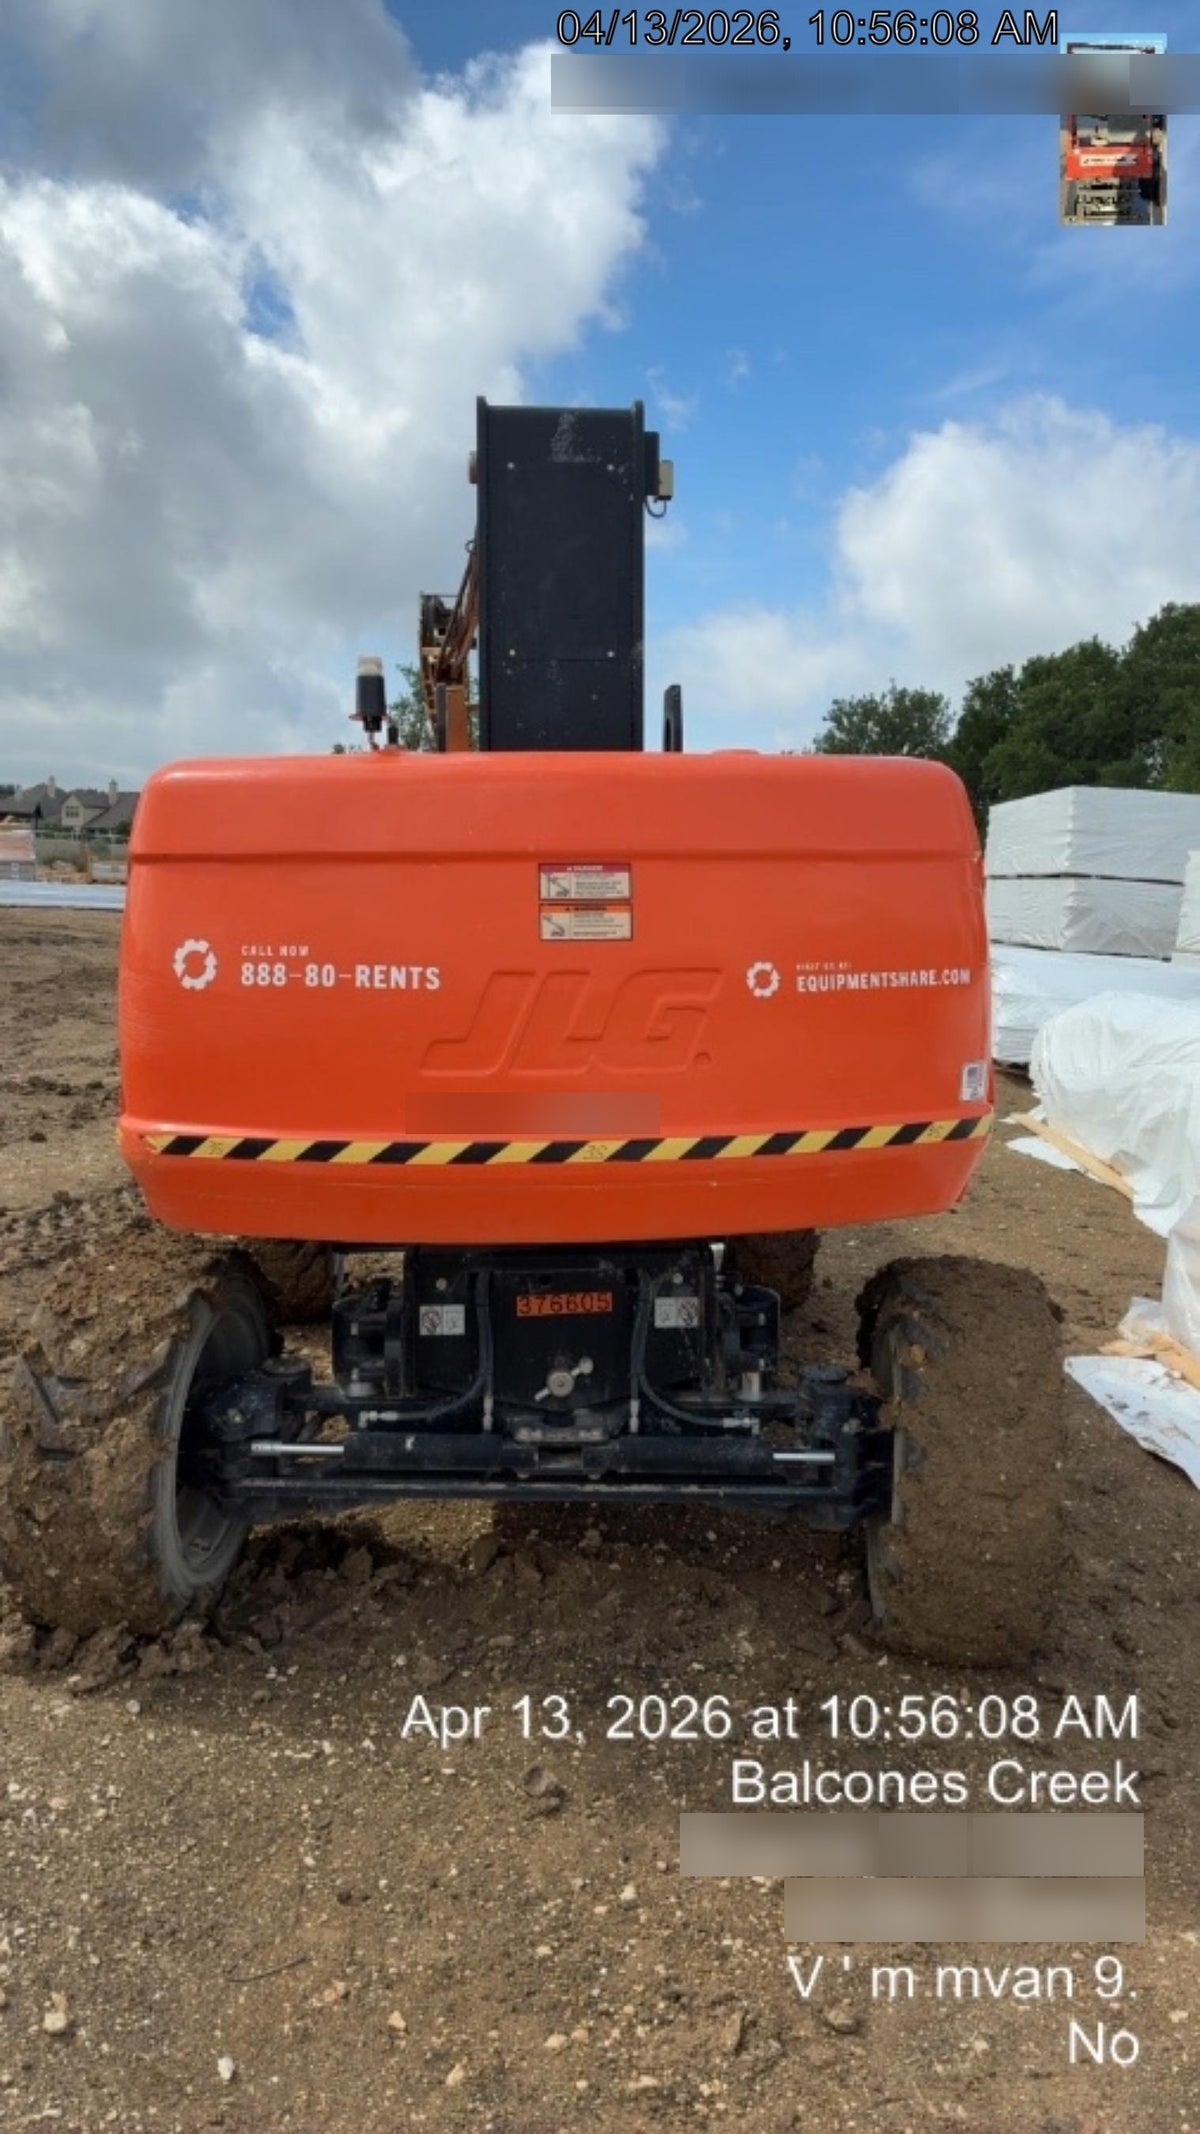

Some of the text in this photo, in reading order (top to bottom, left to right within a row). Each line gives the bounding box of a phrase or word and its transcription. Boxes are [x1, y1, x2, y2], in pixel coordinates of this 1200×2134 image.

[240, 945, 310, 957] CALL NOW
[240, 961, 441, 990] 888-80-RENTS
[796, 968, 972, 993] EQUIPMENTSHARE.COM
[518, 1293, 611, 1314] 376605
